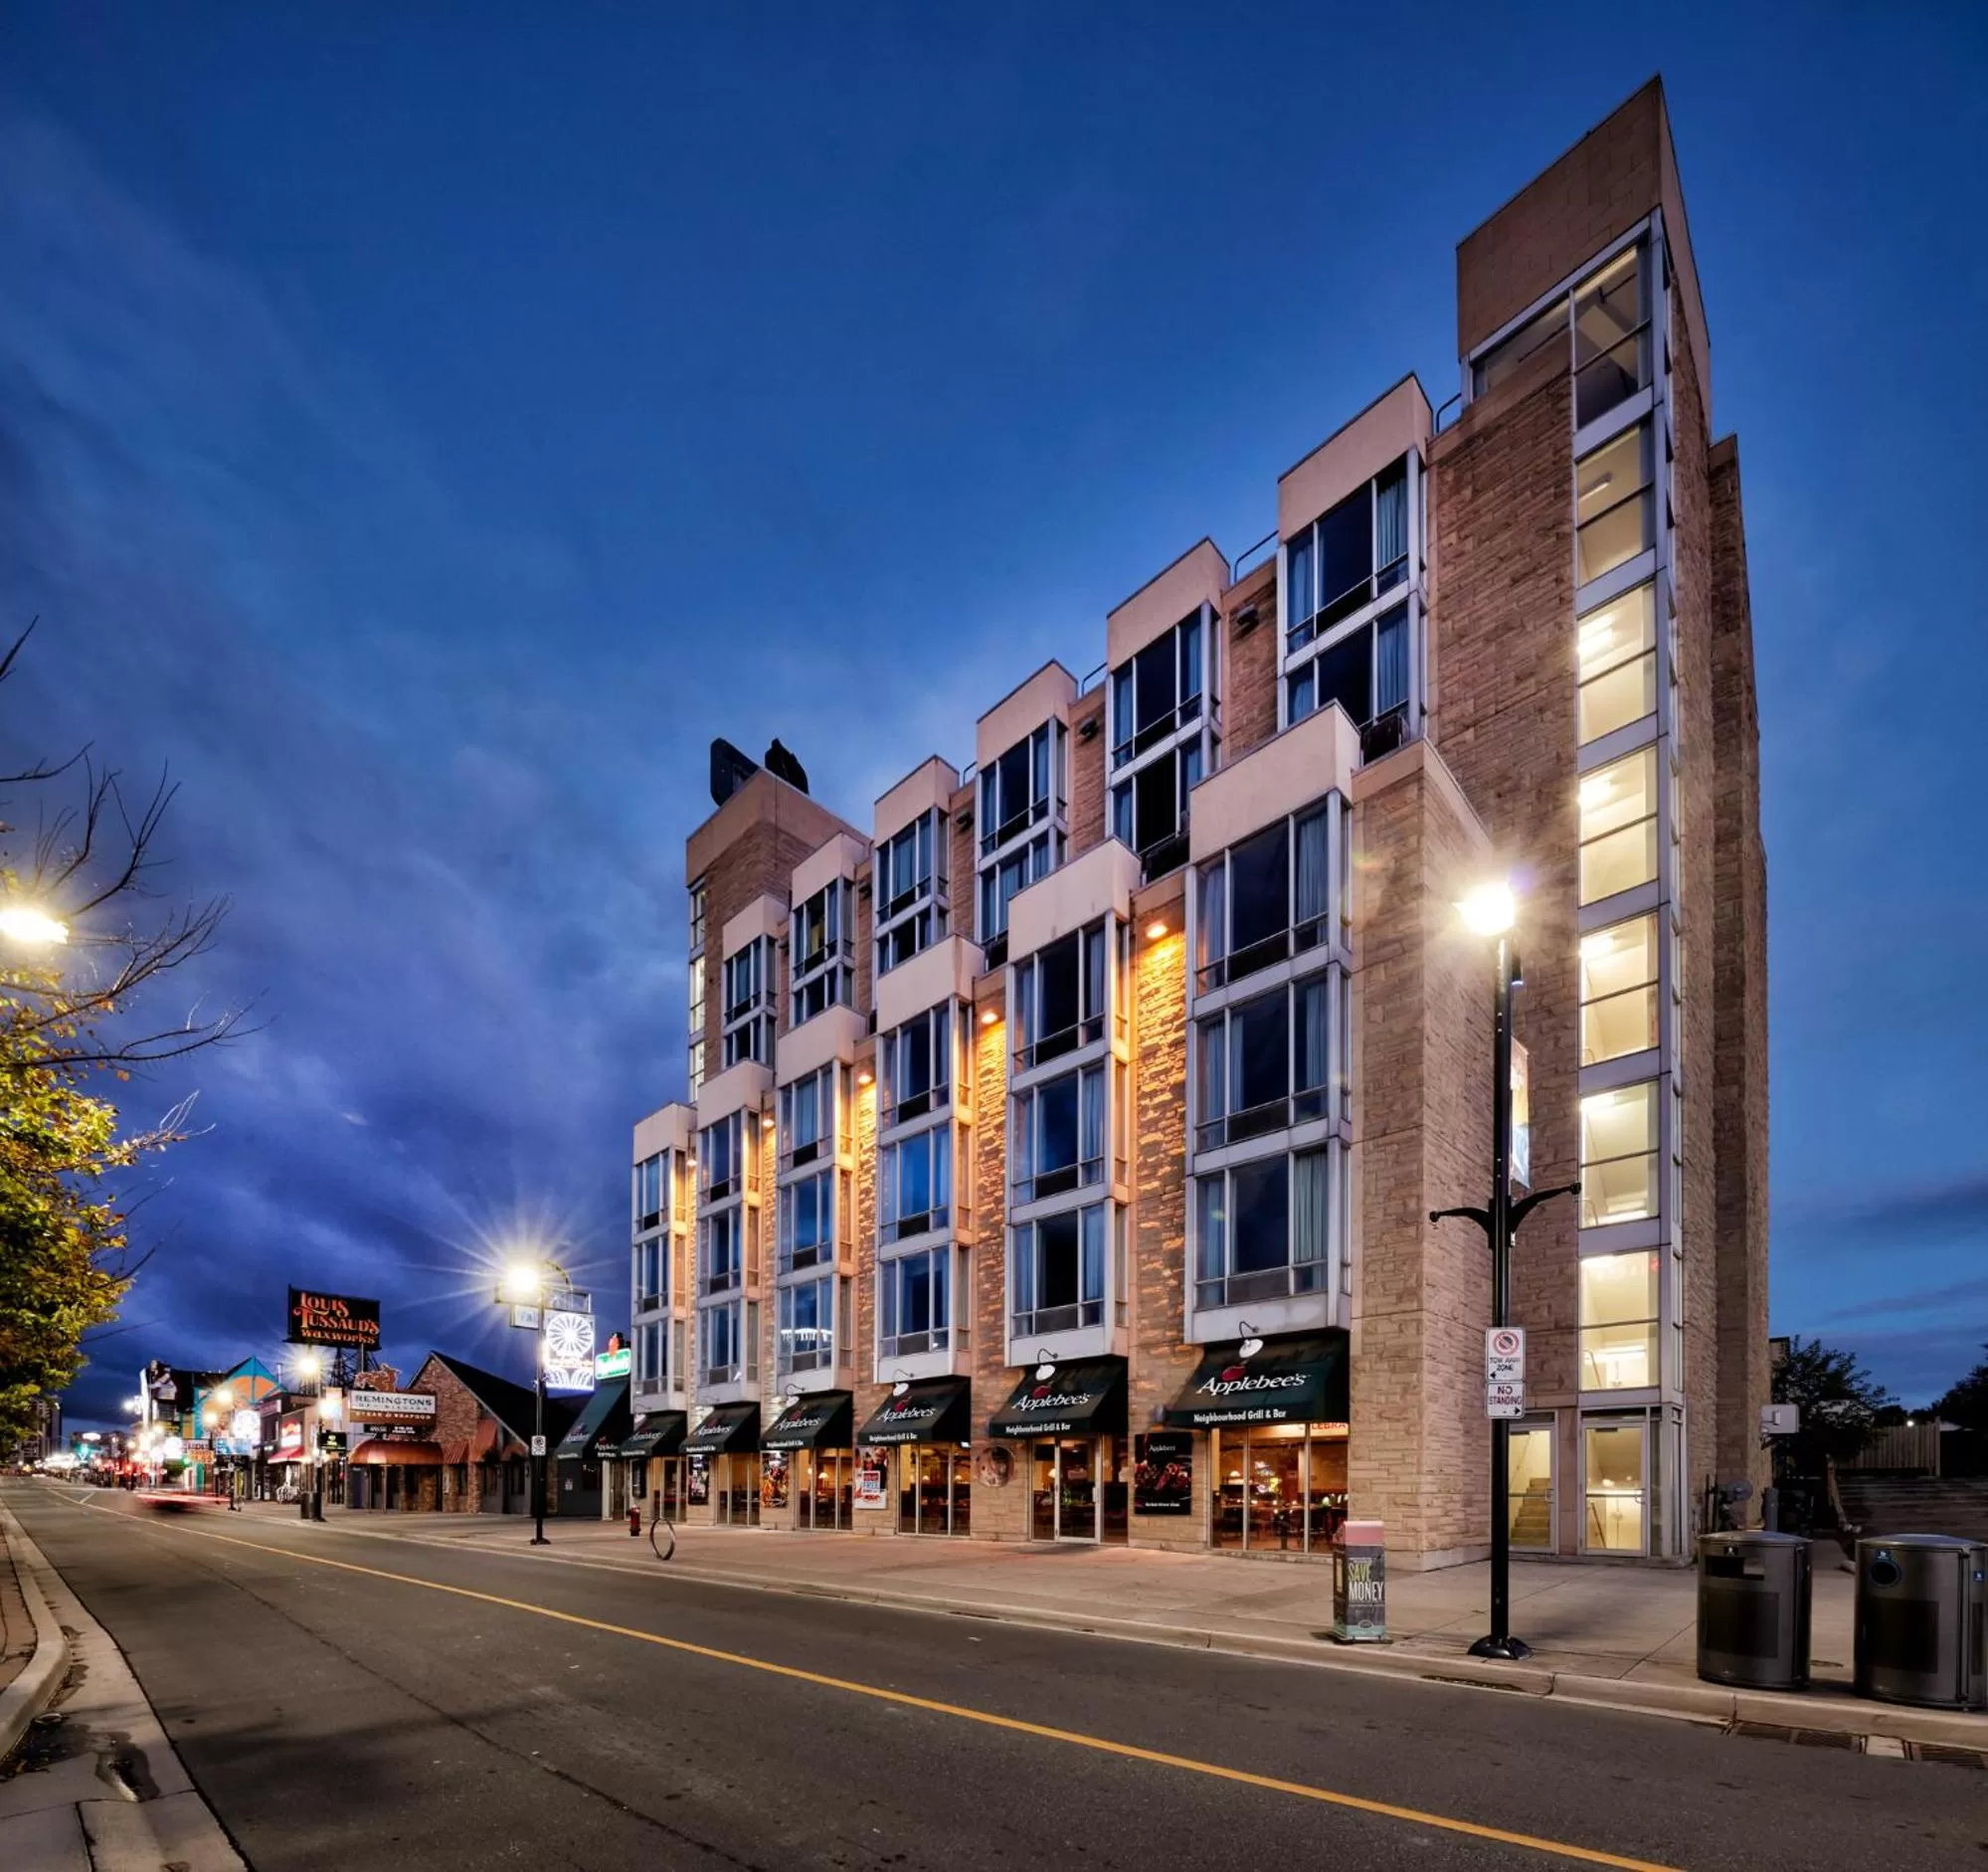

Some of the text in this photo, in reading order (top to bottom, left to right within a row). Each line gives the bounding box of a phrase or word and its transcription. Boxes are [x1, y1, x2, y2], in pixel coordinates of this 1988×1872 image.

[300, 1292, 349, 1318] LOUIS
[293, 1307, 380, 1335] TUSSAUD'S
[1196, 1373, 1306, 1396] Applebee's
[1497, 1385, 1513, 1395] NO
[355, 1395, 432, 1405] REMINGTONS
[1011, 1393, 1090, 1411] Applebee's
[1489, 1396, 1522, 1404] STANDING
[1193, 1408, 1287, 1424] Neighbourhood Grill & Bar
[1348, 1563, 1371, 1582] SAVE
[1348, 1582, 1383, 1601] MONEY
